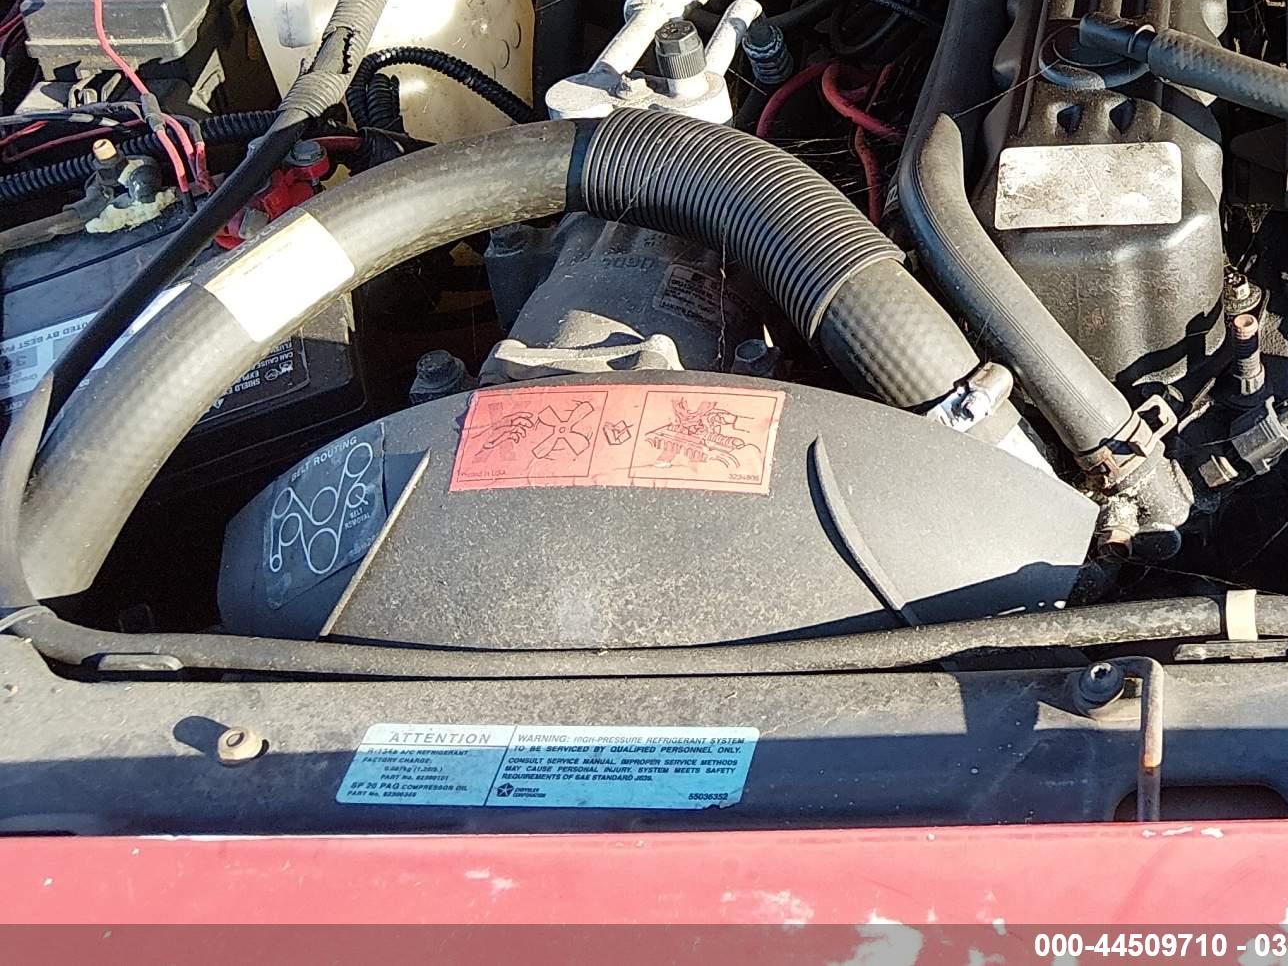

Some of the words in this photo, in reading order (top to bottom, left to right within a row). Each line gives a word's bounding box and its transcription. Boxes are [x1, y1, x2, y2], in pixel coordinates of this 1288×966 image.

[18, 335, 43, 351] BEST
[234, 377, 261, 392] SHIELD
[291, 461, 311, 482] BELT
[313, 436, 357, 466] ROUTING
[388, 733, 491, 745] ATTENTION
[518, 734, 570, 743] WARNING:
[401, 783, 454, 791] COMPRESSOR
